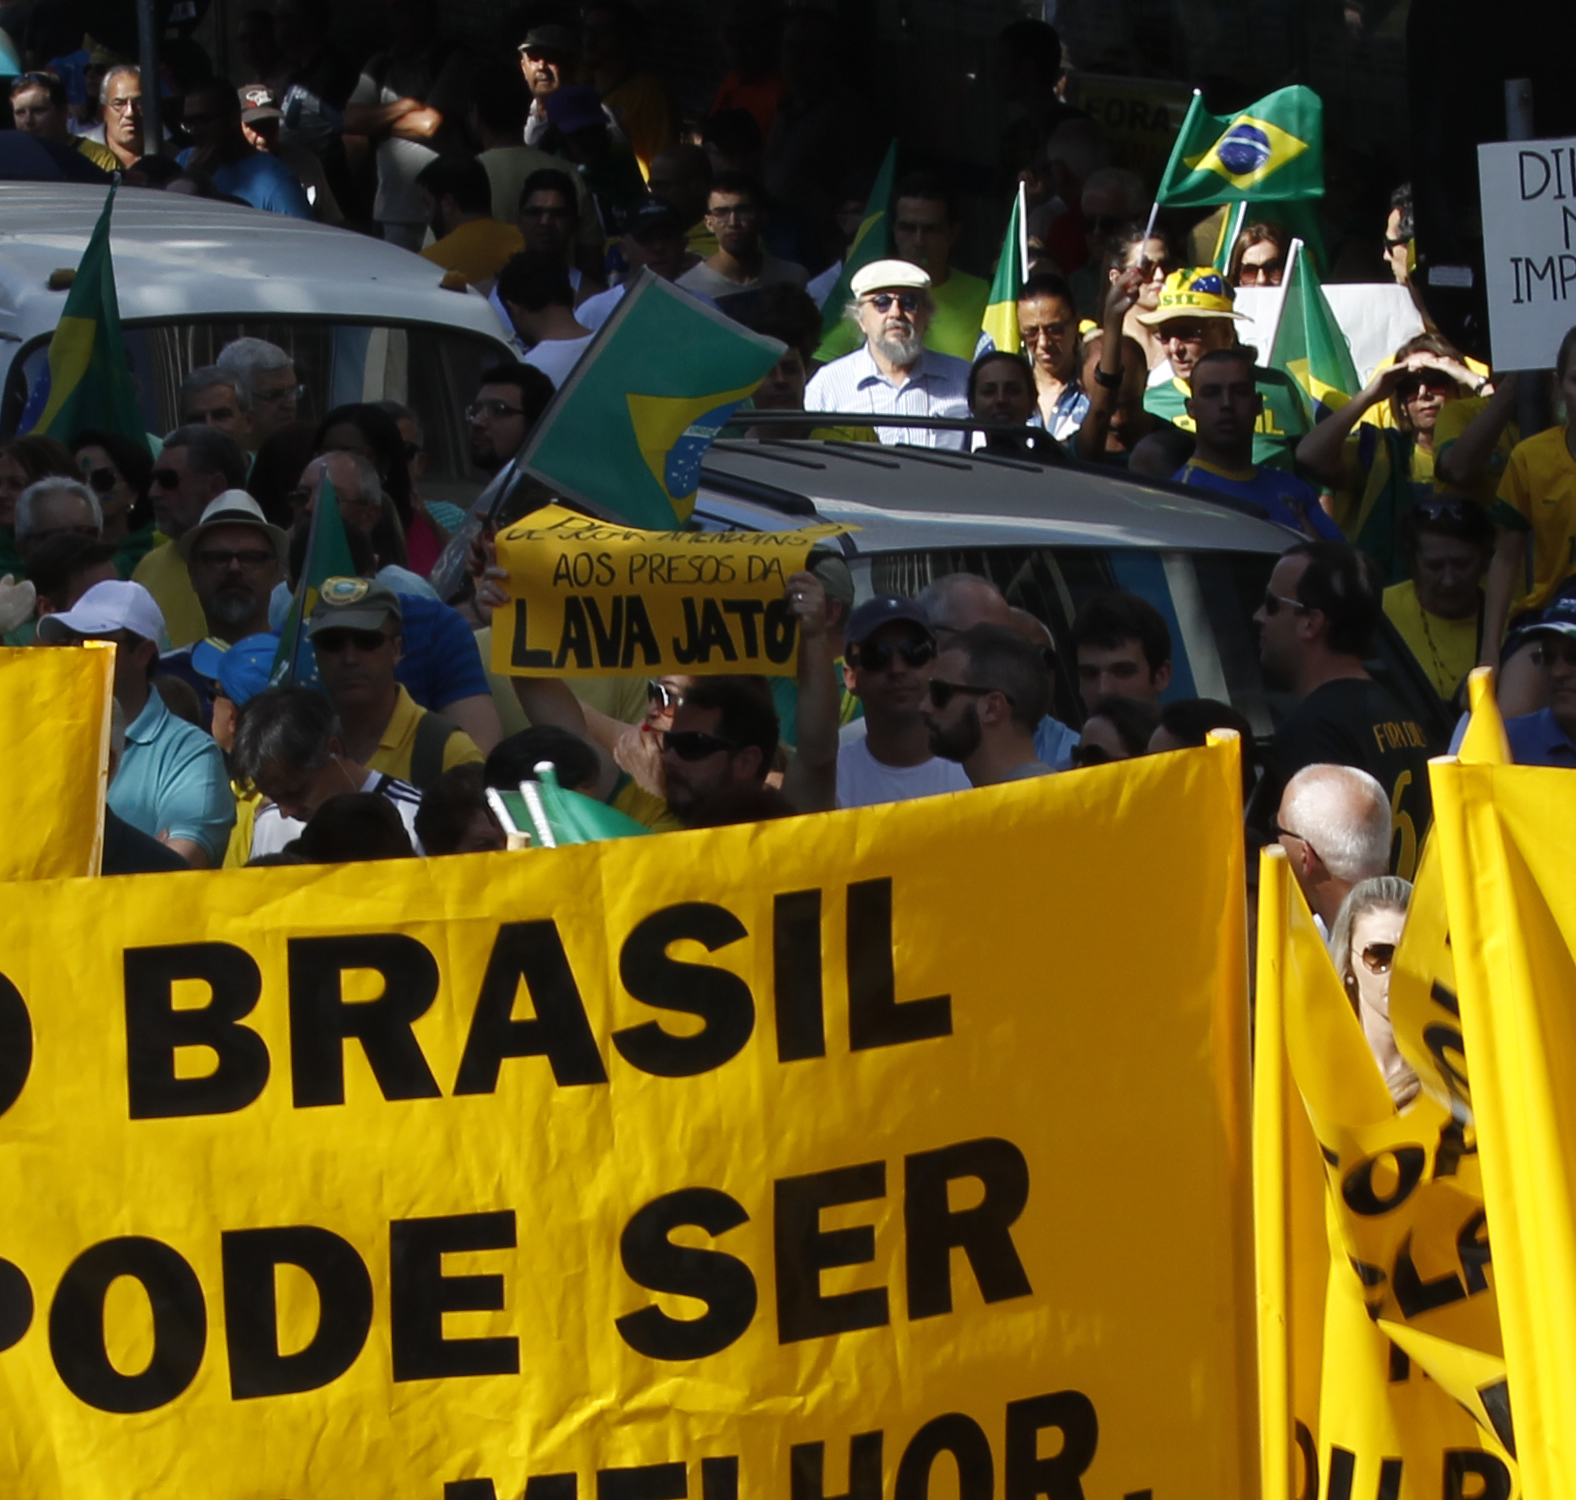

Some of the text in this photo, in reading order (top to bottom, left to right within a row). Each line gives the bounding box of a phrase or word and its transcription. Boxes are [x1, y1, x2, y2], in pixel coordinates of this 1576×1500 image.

[510, 594, 800, 669] LAVA JATO
[552, 552, 786, 588] AOS PRESOS DA
[122, 876, 953, 1120] BRASIL
[616, 1136, 1032, 1362] SER
